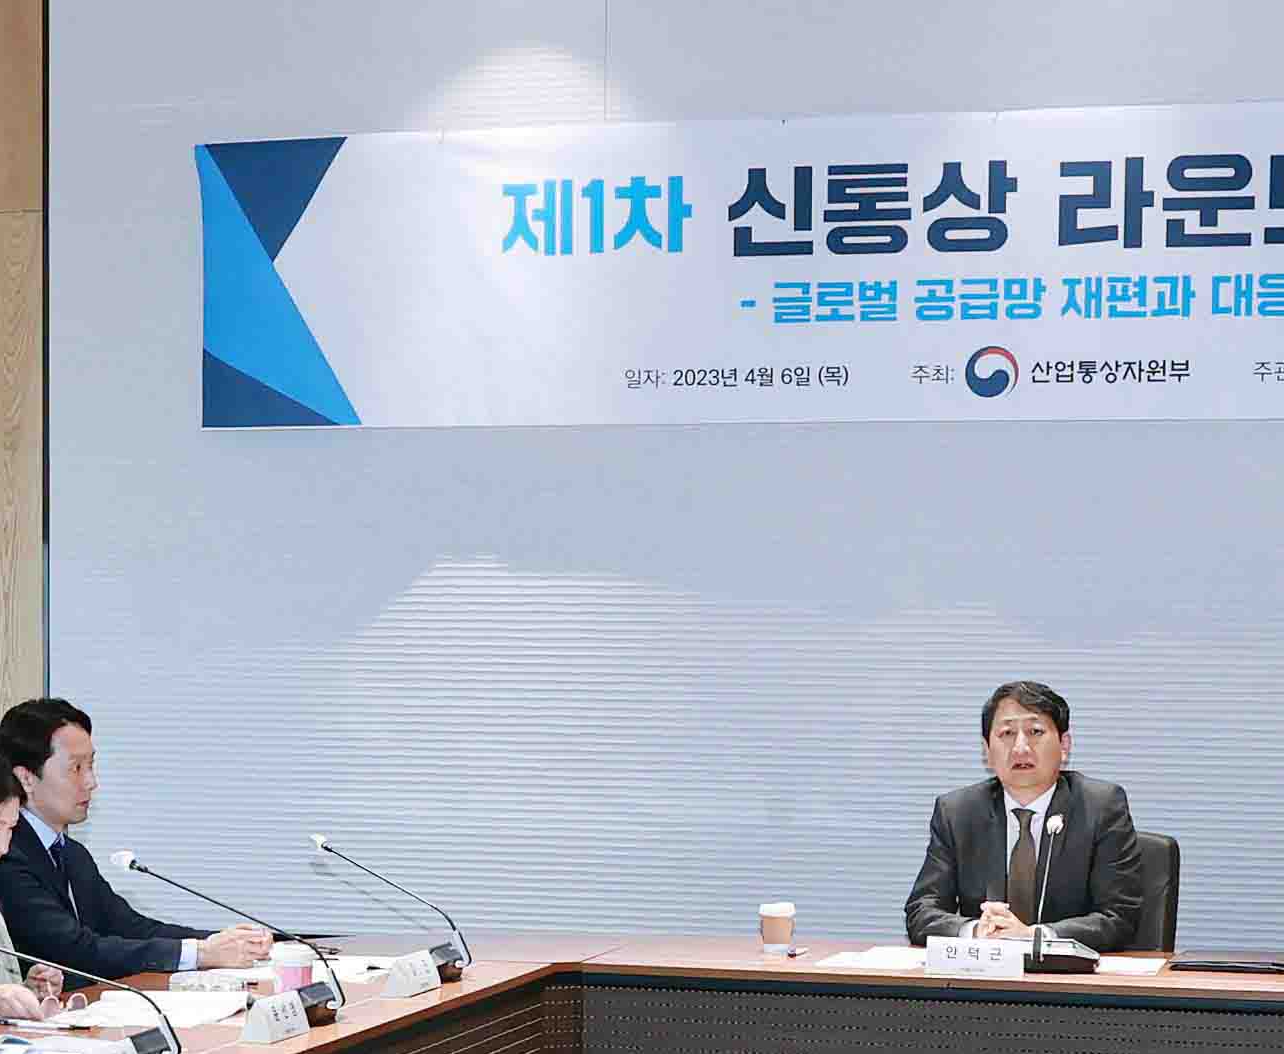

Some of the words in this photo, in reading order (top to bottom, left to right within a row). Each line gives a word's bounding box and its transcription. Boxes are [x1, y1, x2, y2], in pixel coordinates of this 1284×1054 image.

[503, 176, 694, 256] 제1차
[728, 160, 1017, 257] 신통상
[772, 280, 898, 324] 글로벌
[914, 278, 1046, 321] 공급망
[1061, 275, 1196, 319] 재편과
[625, 368, 668, 389] 일자:
[673, 368, 739, 387] 2023년
[744, 367, 774, 387] 4월
[781, 366, 810, 386] 6일
[818, 365, 848, 387] (목)
[911, 363, 955, 384] 주최:
[1031, 360, 1190, 384] 산업통상자원부
